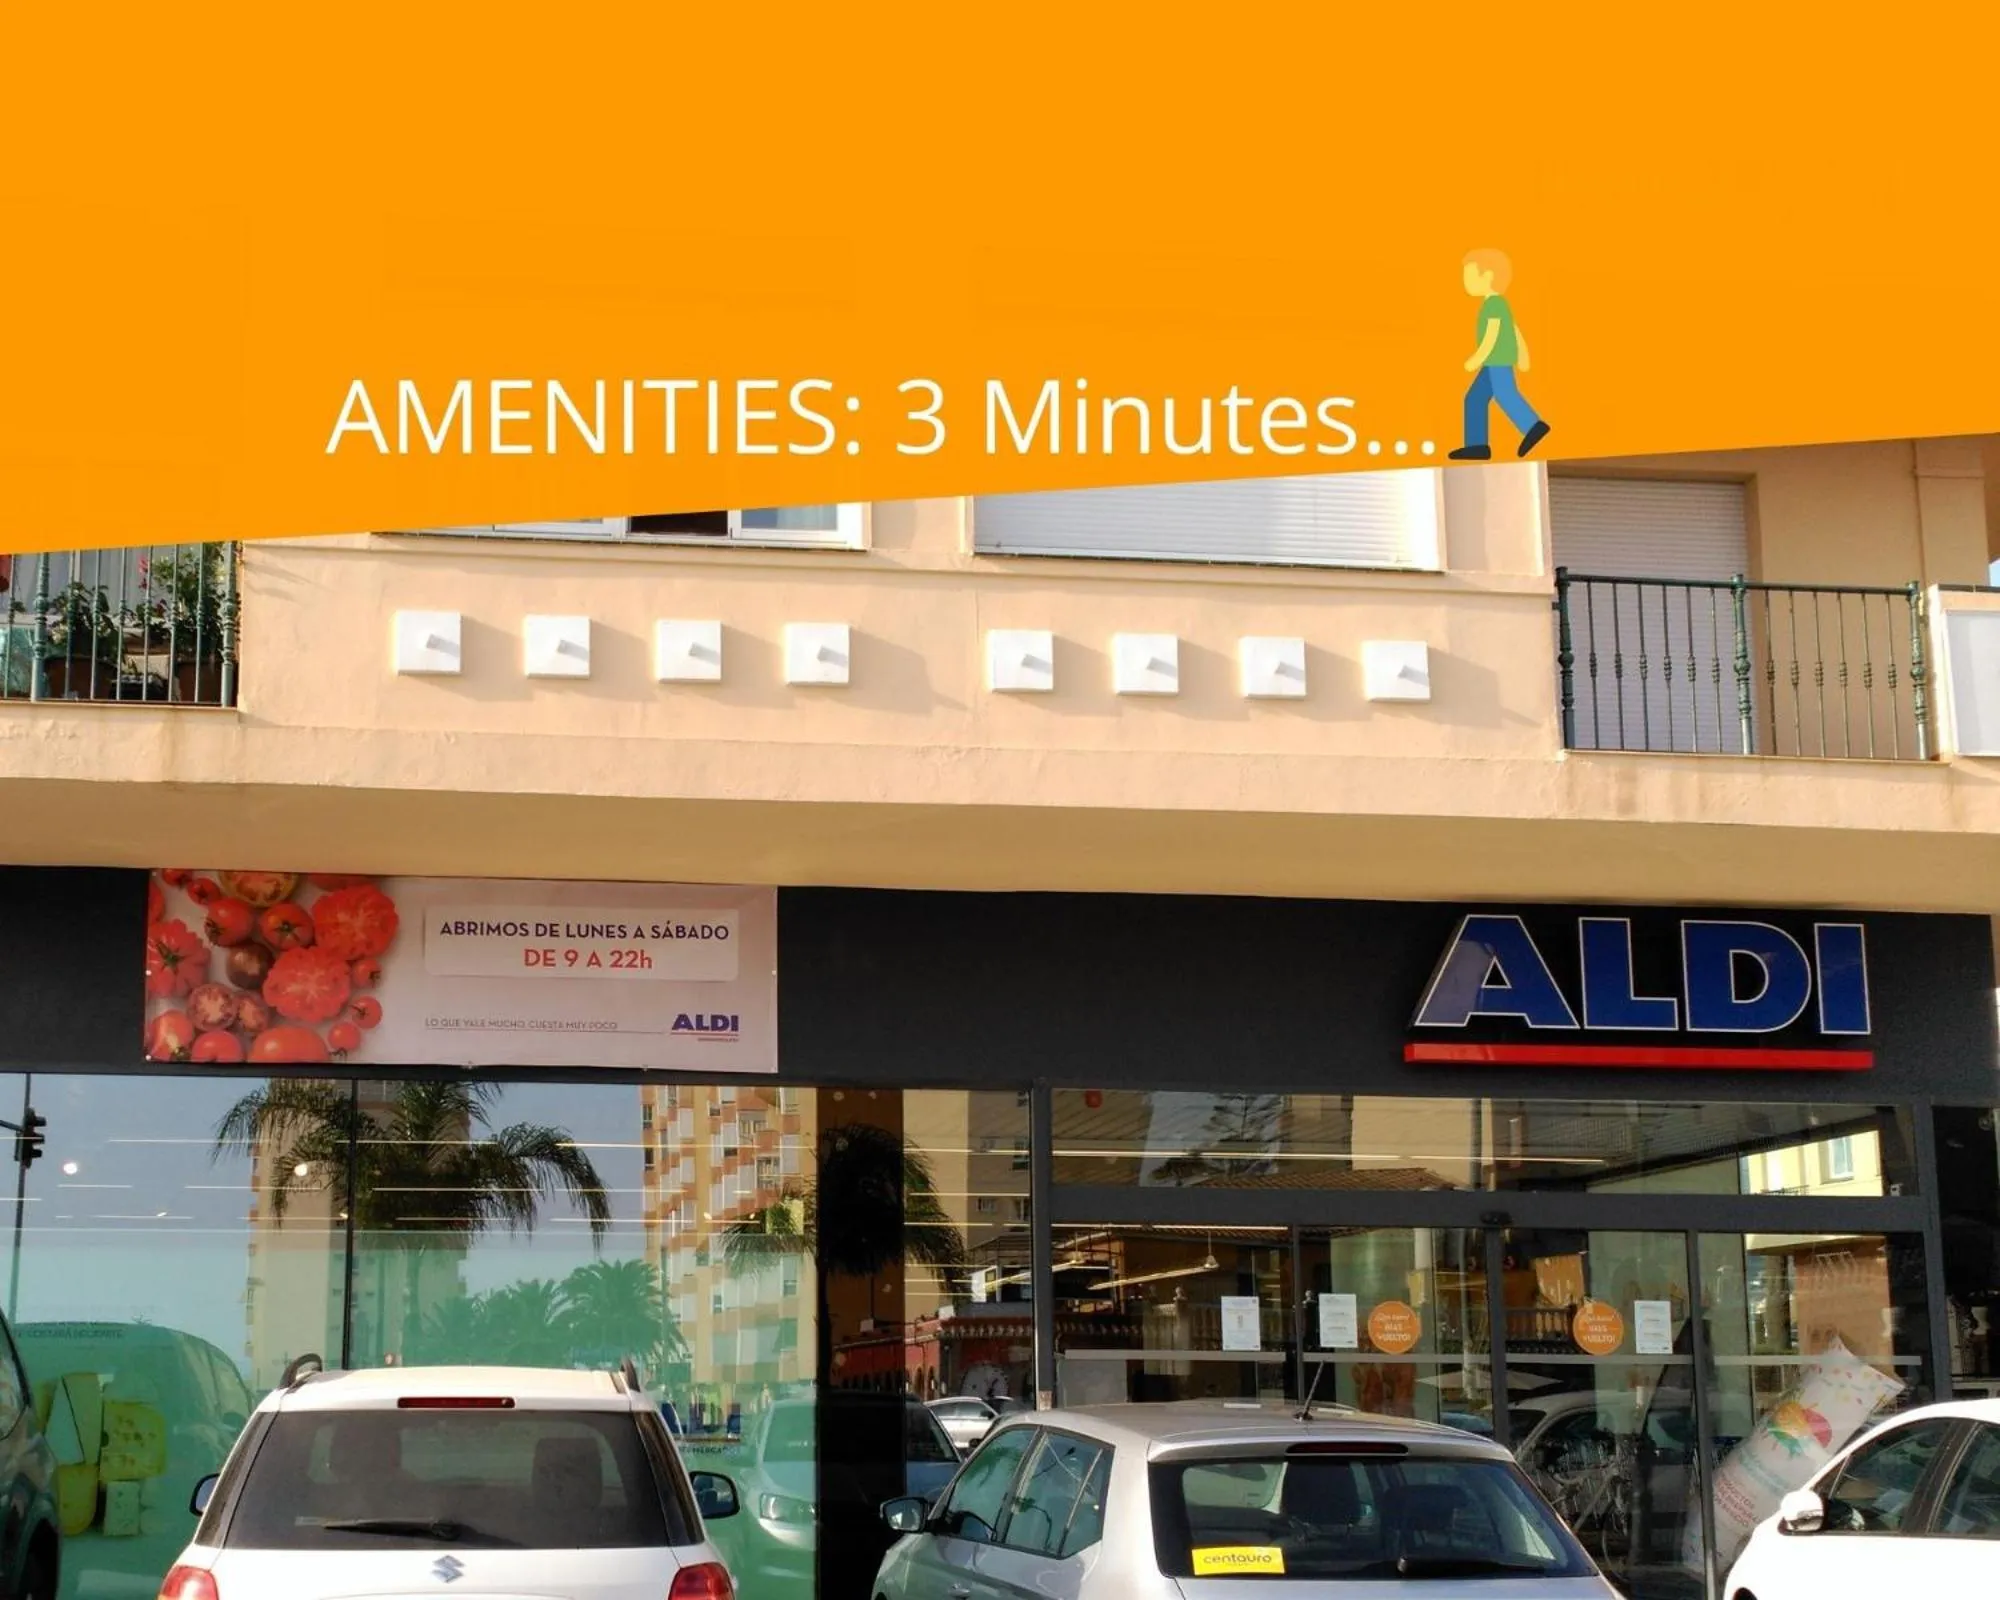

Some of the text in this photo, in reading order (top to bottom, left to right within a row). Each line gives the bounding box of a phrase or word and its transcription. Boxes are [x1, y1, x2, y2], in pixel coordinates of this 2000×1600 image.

[440, 920, 729, 940] ABRIMOS DE LUNES A SÁBADO
[523, 949, 653, 969] DE 9 A 22h
[1413, 914, 1872, 1035] ALDI
[671, 1013, 739, 1032] ALDI
